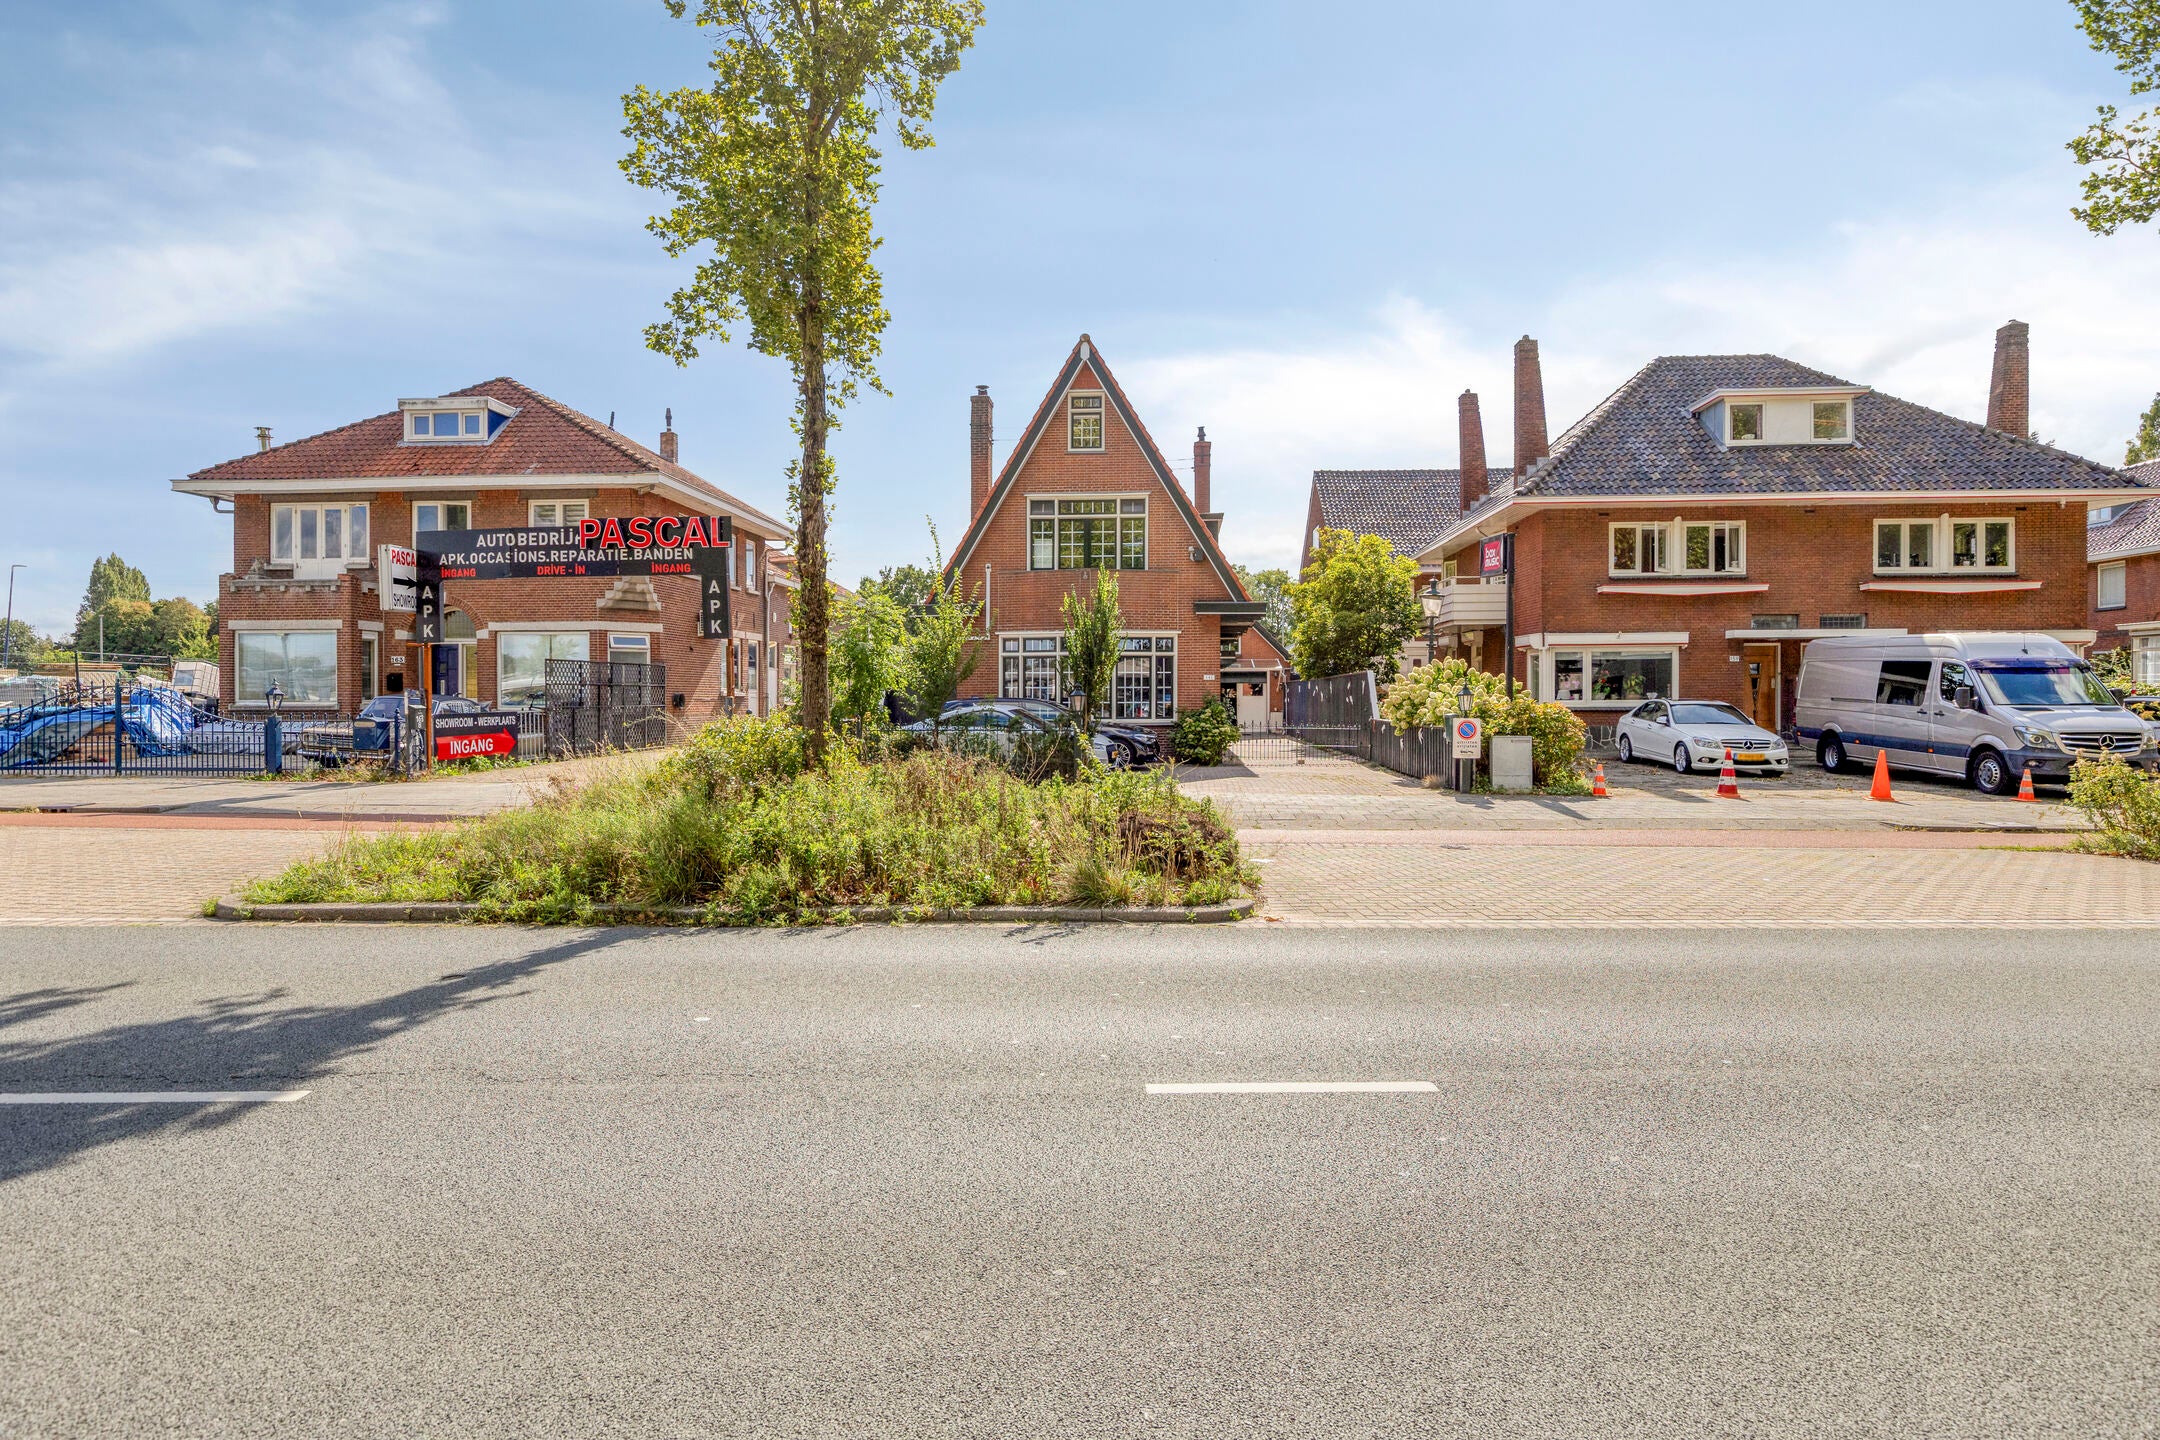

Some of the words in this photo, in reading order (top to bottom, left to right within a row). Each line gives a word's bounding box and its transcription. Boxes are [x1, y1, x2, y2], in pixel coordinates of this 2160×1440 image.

[579, 516, 731, 549] PASCAL
[435, 717, 474, 728] SHOWROOM
[477, 715, 516, 727] WERKPLAATS
[450, 738, 494, 755] INGANG
